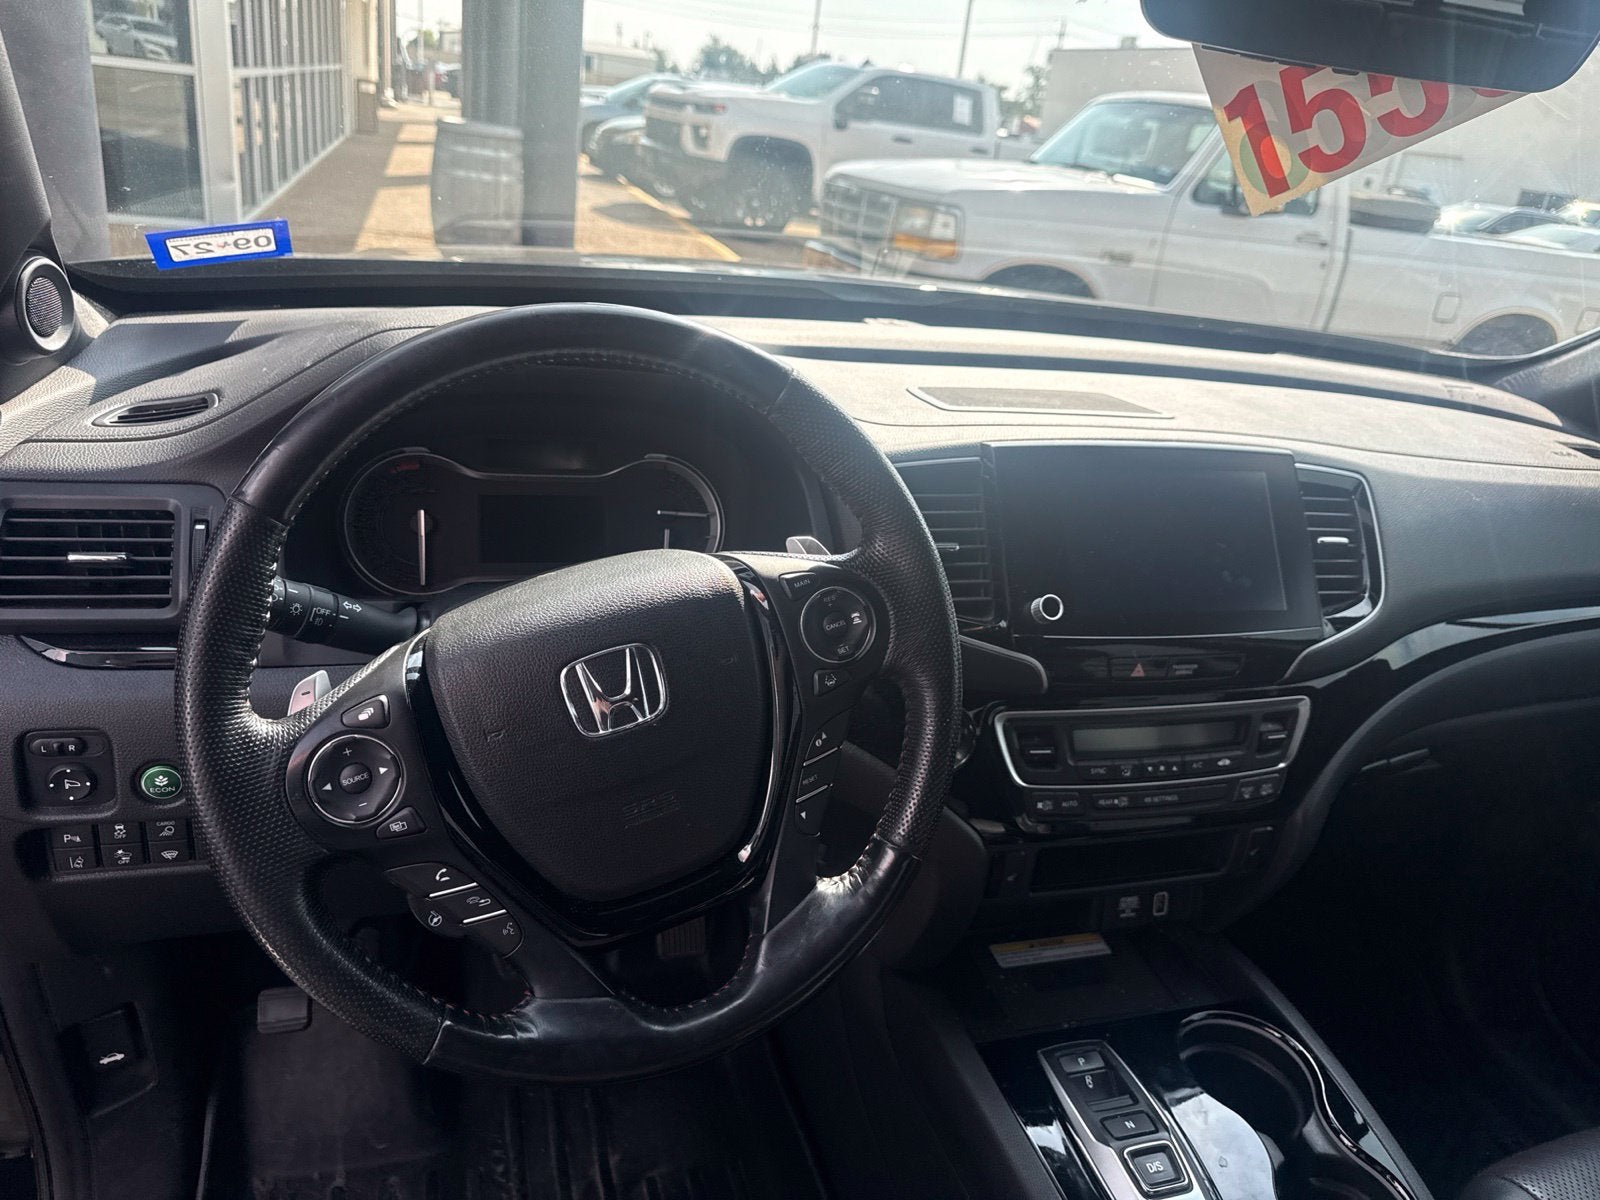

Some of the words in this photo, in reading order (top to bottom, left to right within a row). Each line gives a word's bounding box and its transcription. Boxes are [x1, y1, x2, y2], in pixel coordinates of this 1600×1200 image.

[1223, 66, 1508, 198] 155
[315, 606, 331, 616] OFF
[826, 620, 846, 631] CANCEL
[837, 646, 849, 655] SET
[41, 745, 47, 753] L
[68, 744, 76, 752] R
[341, 771, 369, 787] SOURCE
[150, 786, 176, 794] ECON
[63, 834, 71, 843] P
[1077, 1057, 1086, 1067] P
[1124, 1120, 1136, 1129] N
[1145, 1160, 1164, 1173] D/S
